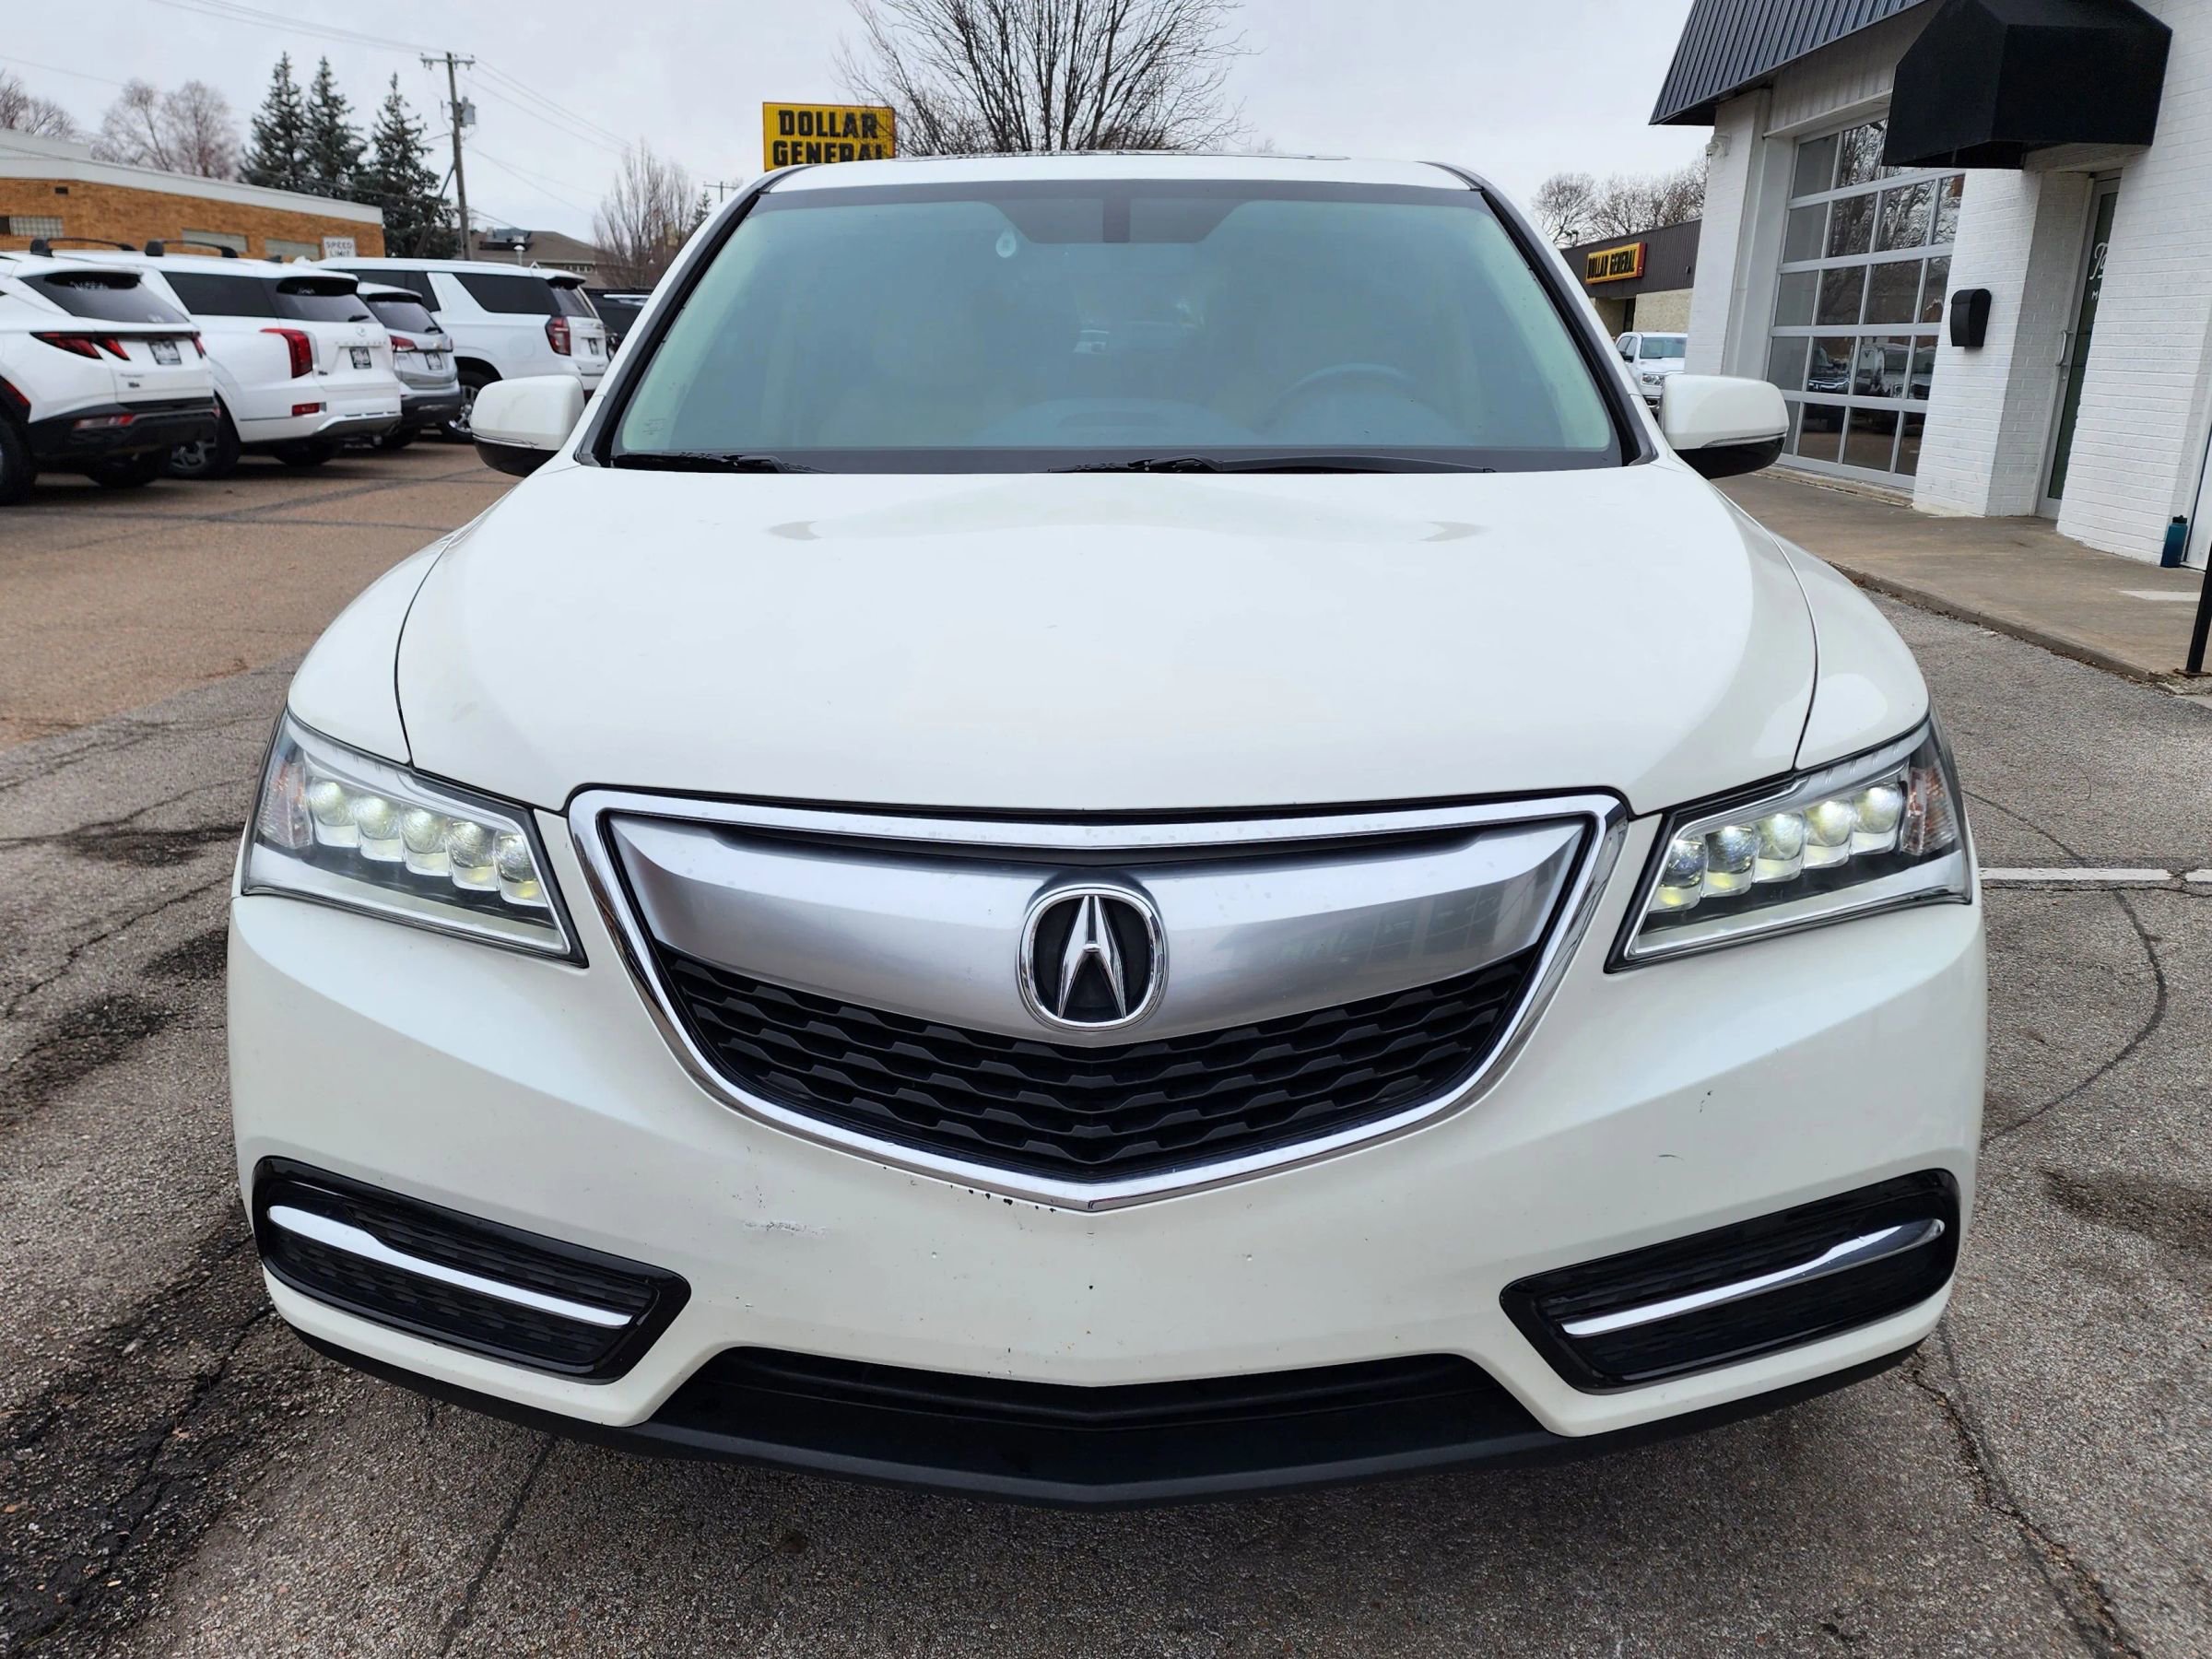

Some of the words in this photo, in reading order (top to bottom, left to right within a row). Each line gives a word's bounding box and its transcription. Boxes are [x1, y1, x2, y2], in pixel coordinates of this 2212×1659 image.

[778, 110, 878, 138] DOLLAR
[1587, 255, 1609, 279] DOLLAR
[1609, 249, 1637, 276] GENERAL
